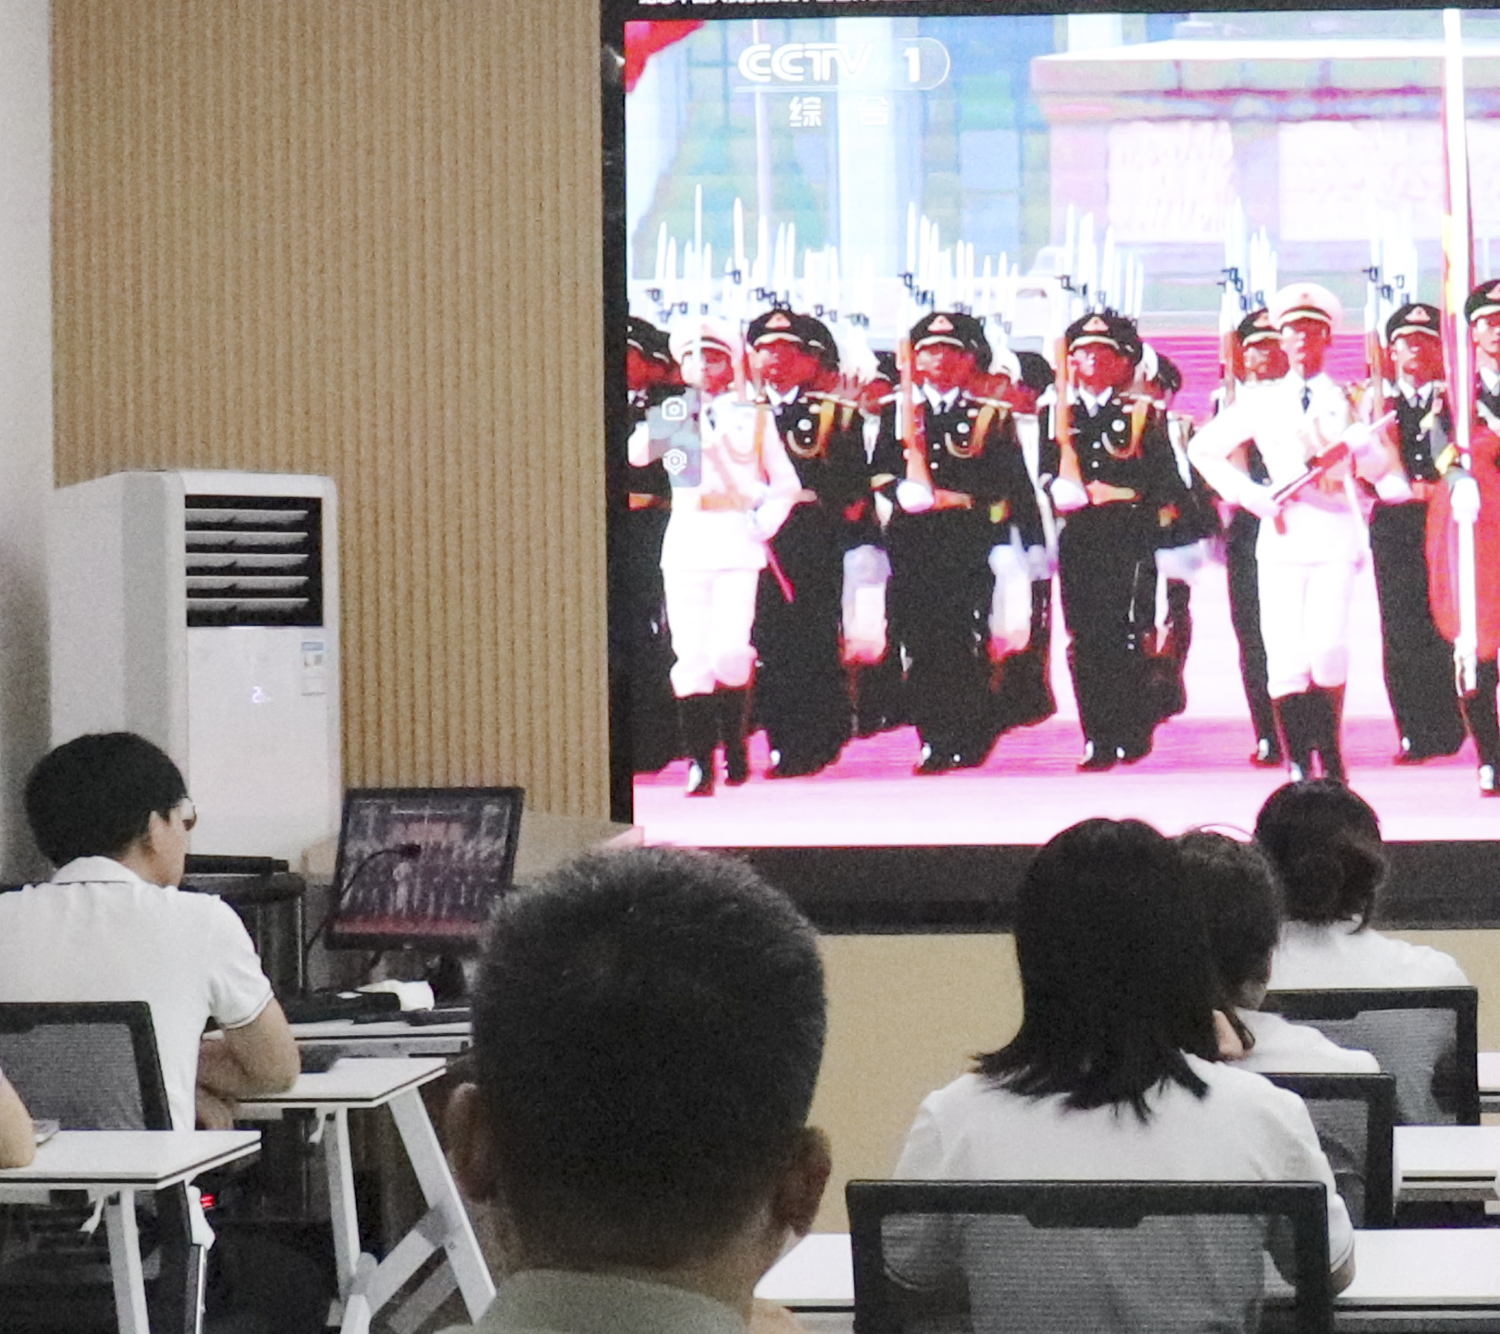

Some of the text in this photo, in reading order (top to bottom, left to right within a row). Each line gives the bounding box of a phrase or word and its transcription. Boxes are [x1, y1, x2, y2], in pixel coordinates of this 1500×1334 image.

[738, 43, 920, 83] CCTV 1
[789, 95, 889, 128] 综合
